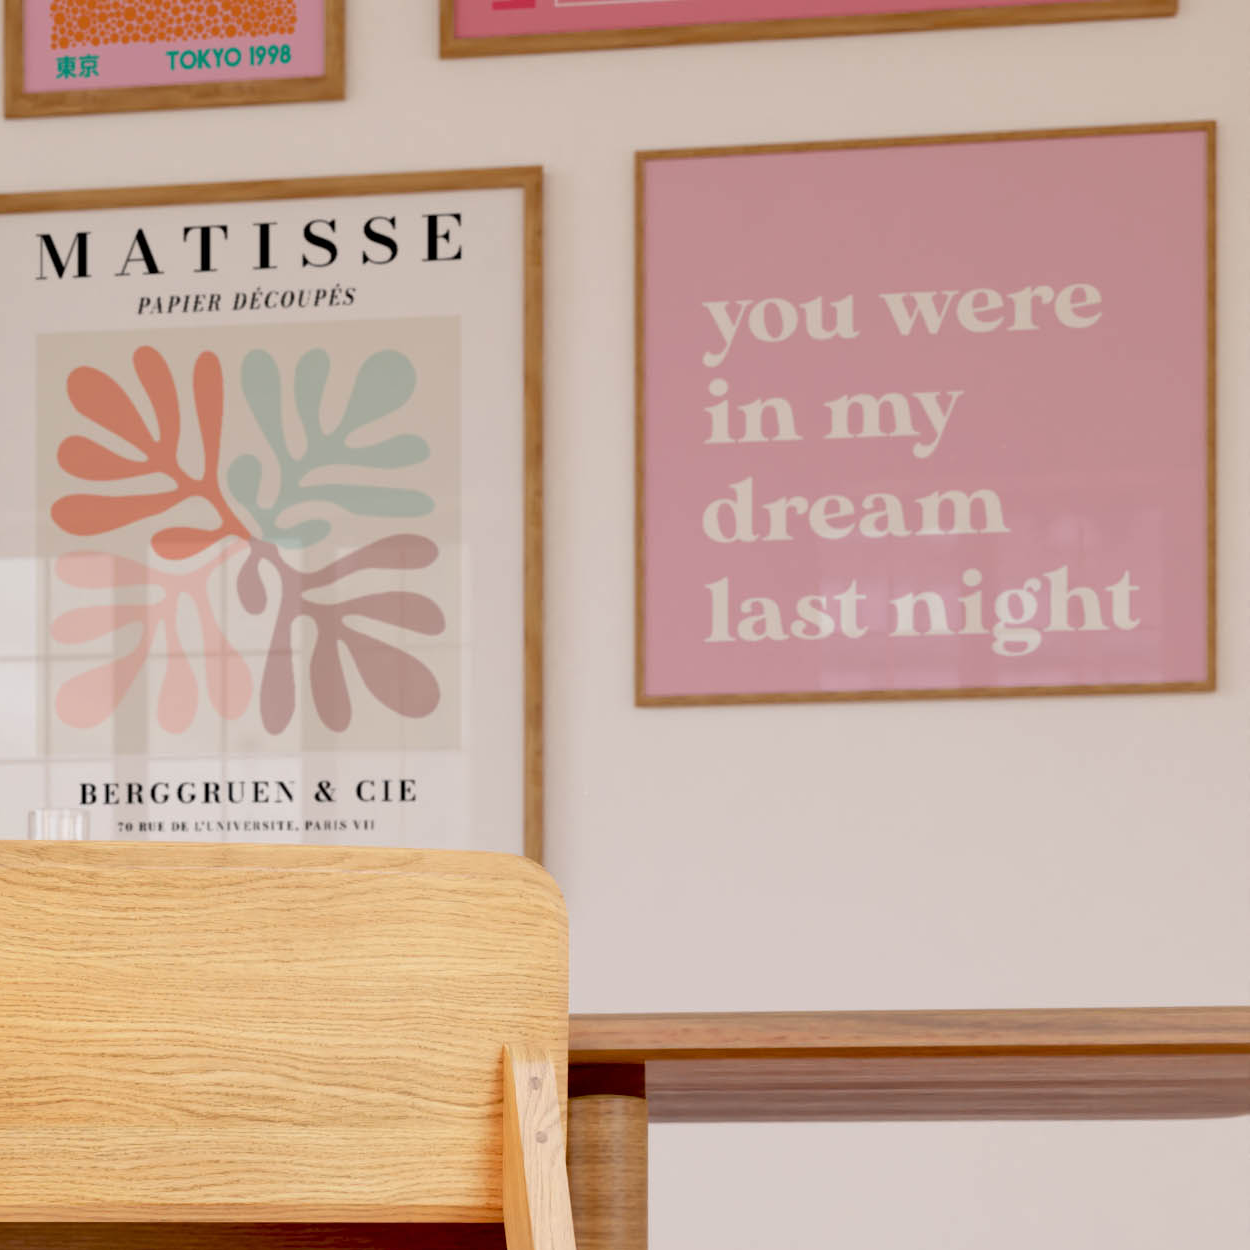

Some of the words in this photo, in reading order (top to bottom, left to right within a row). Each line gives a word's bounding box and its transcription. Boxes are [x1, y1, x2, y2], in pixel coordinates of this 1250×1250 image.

[55, 54, 100, 79] 東京
[166, 48, 241, 71] TOKYO
[250, 45, 291, 65] 1998
[35, 212, 462, 280] MATISSE
[137, 293, 222, 315] PAPIER
[232, 283, 356, 311] DÉCOUPÉS
[702, 293, 859, 367] you
[879, 283, 1102, 335] were
[703, 378, 803, 444] in
[823, 389, 964, 459] my
[702, 476, 1012, 543] dream
[703, 576, 868, 643] last
[888, 564, 1141, 657] night
[79, 780, 295, 805] BERGGRUEN
[314, 780, 335, 802] &
[356, 779, 417, 802] CIE
[117, 821, 133, 832] 70
[139, 821, 165, 832] RUE
[171, 821, 189, 832] DE
[305, 820, 347, 831] PARIS
[353, 819, 376, 830] VII
